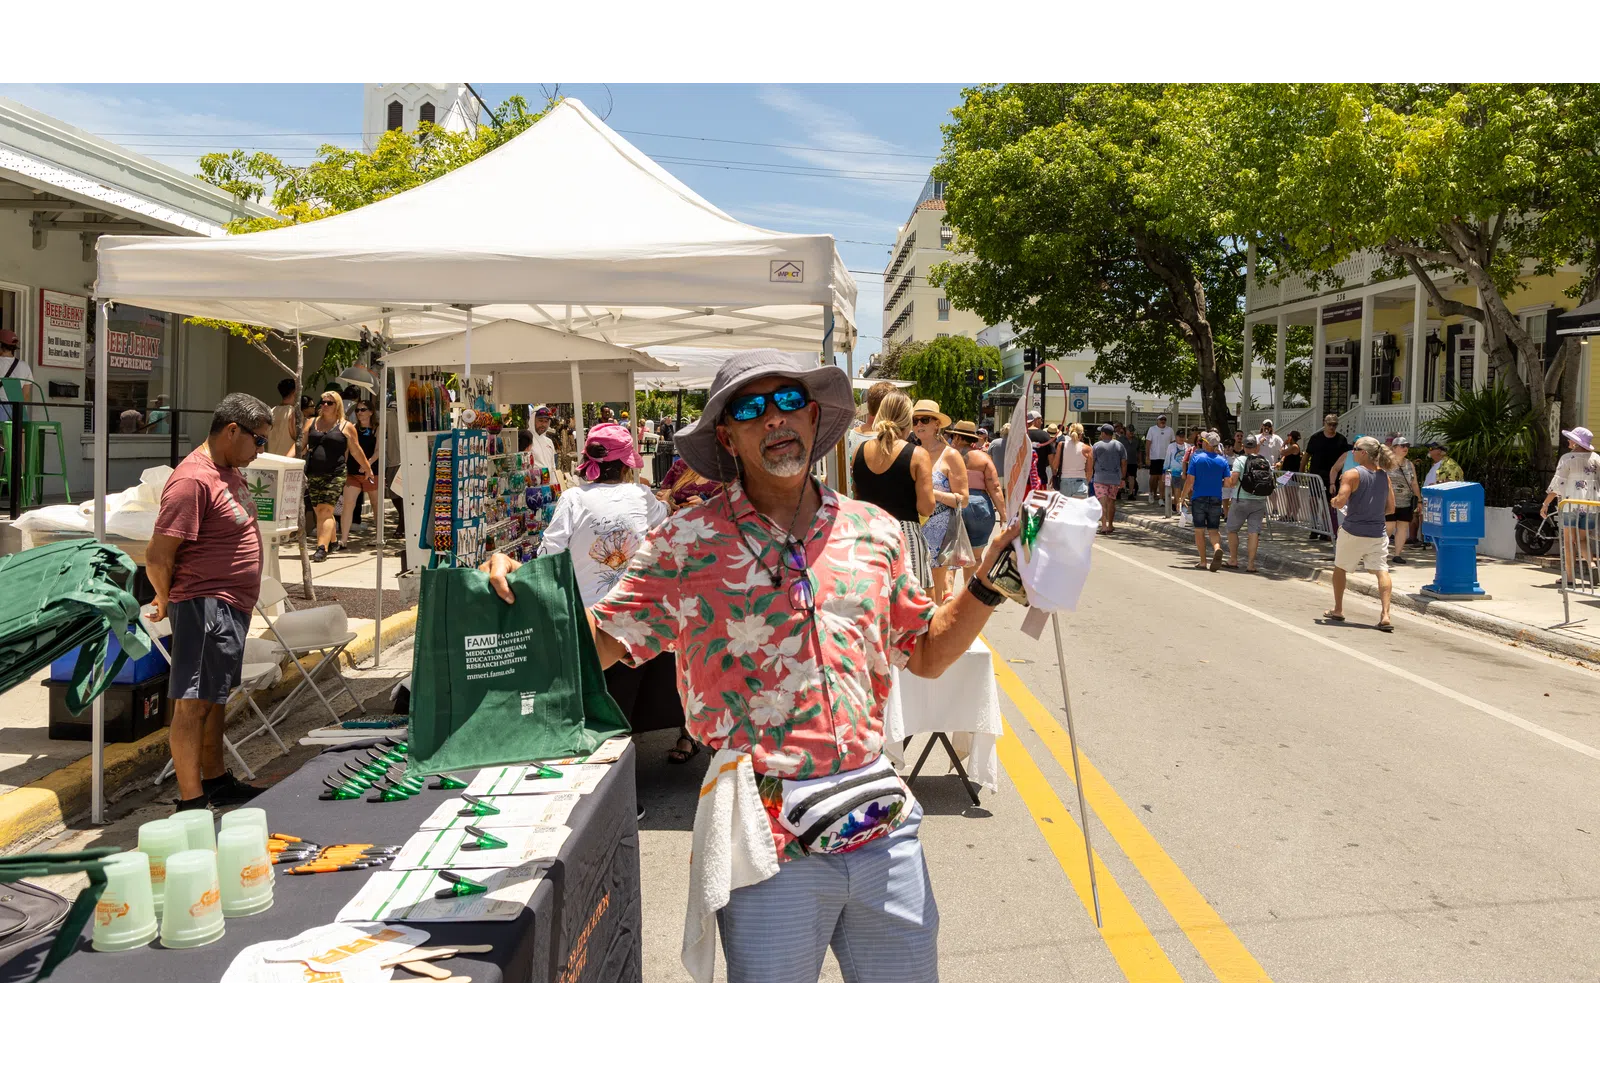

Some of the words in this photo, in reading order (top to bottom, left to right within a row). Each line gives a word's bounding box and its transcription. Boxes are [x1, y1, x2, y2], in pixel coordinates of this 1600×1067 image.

[1336, 293, 1346, 302] 336
[45, 301, 63, 318] BEEF
[63, 304, 84, 321] JERKY
[50, 318, 80, 329] EXPERIENCE
[128, 332, 160, 359] JERKY
[110, 356, 152, 370] EXPERIENCE
[285, 472, 302, 482] FREE
[497, 631, 523, 639] FLORIDA
[498, 635, 531, 646] UNIVERSITY
[467, 636, 496, 648] FAMU
[465, 649, 495, 657] MEDICAL
[495, 644, 527, 654] MARIJUANA
[466, 654, 503, 663] EDUCATION
[466, 661, 499, 670] RESEARCH
[499, 656, 528, 666] INITIATIVE
[467, 668, 515, 680] mmeri.famu.edu
